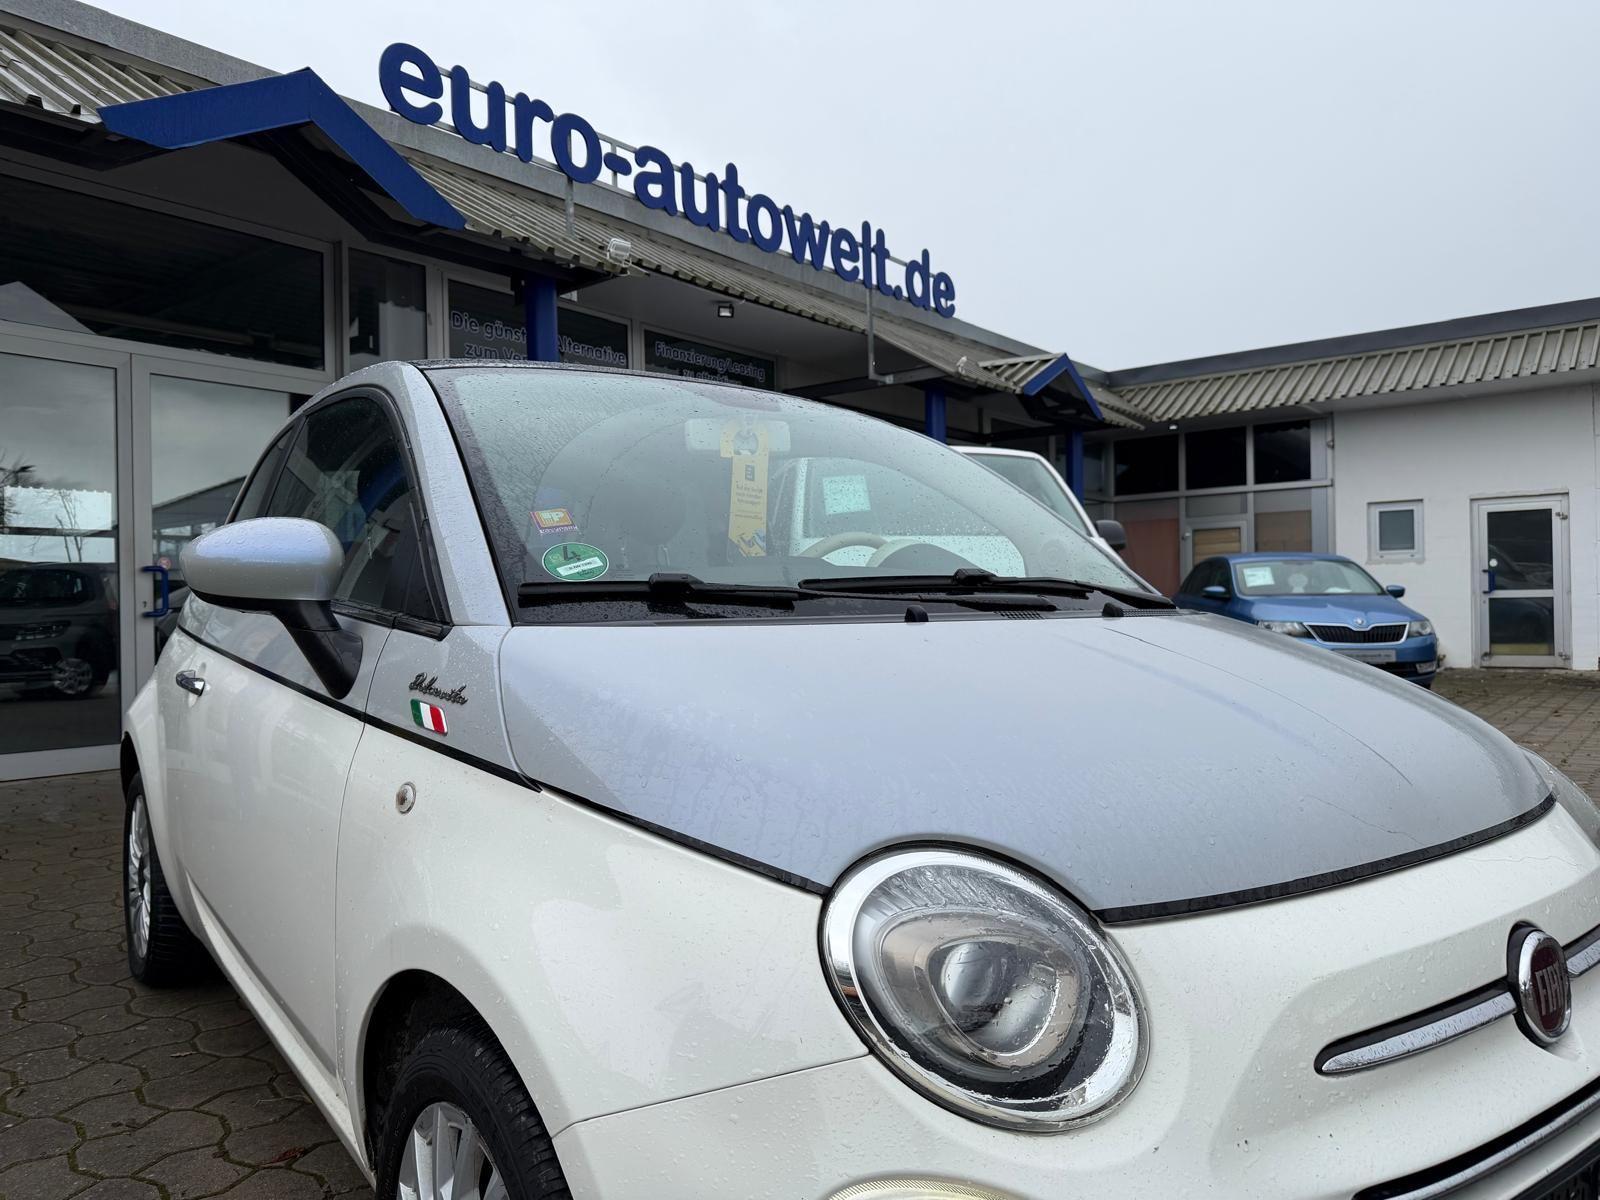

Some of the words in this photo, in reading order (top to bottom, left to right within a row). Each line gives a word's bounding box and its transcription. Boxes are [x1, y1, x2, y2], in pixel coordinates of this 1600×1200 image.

[379, 42, 956, 318] euro-autowelt.de
[451, 310, 480, 333] Die
[483, 320, 527, 343] günst
[464, 342, 498, 359] zum
[655, 341, 766, 382] Finanzierung/Leasing
